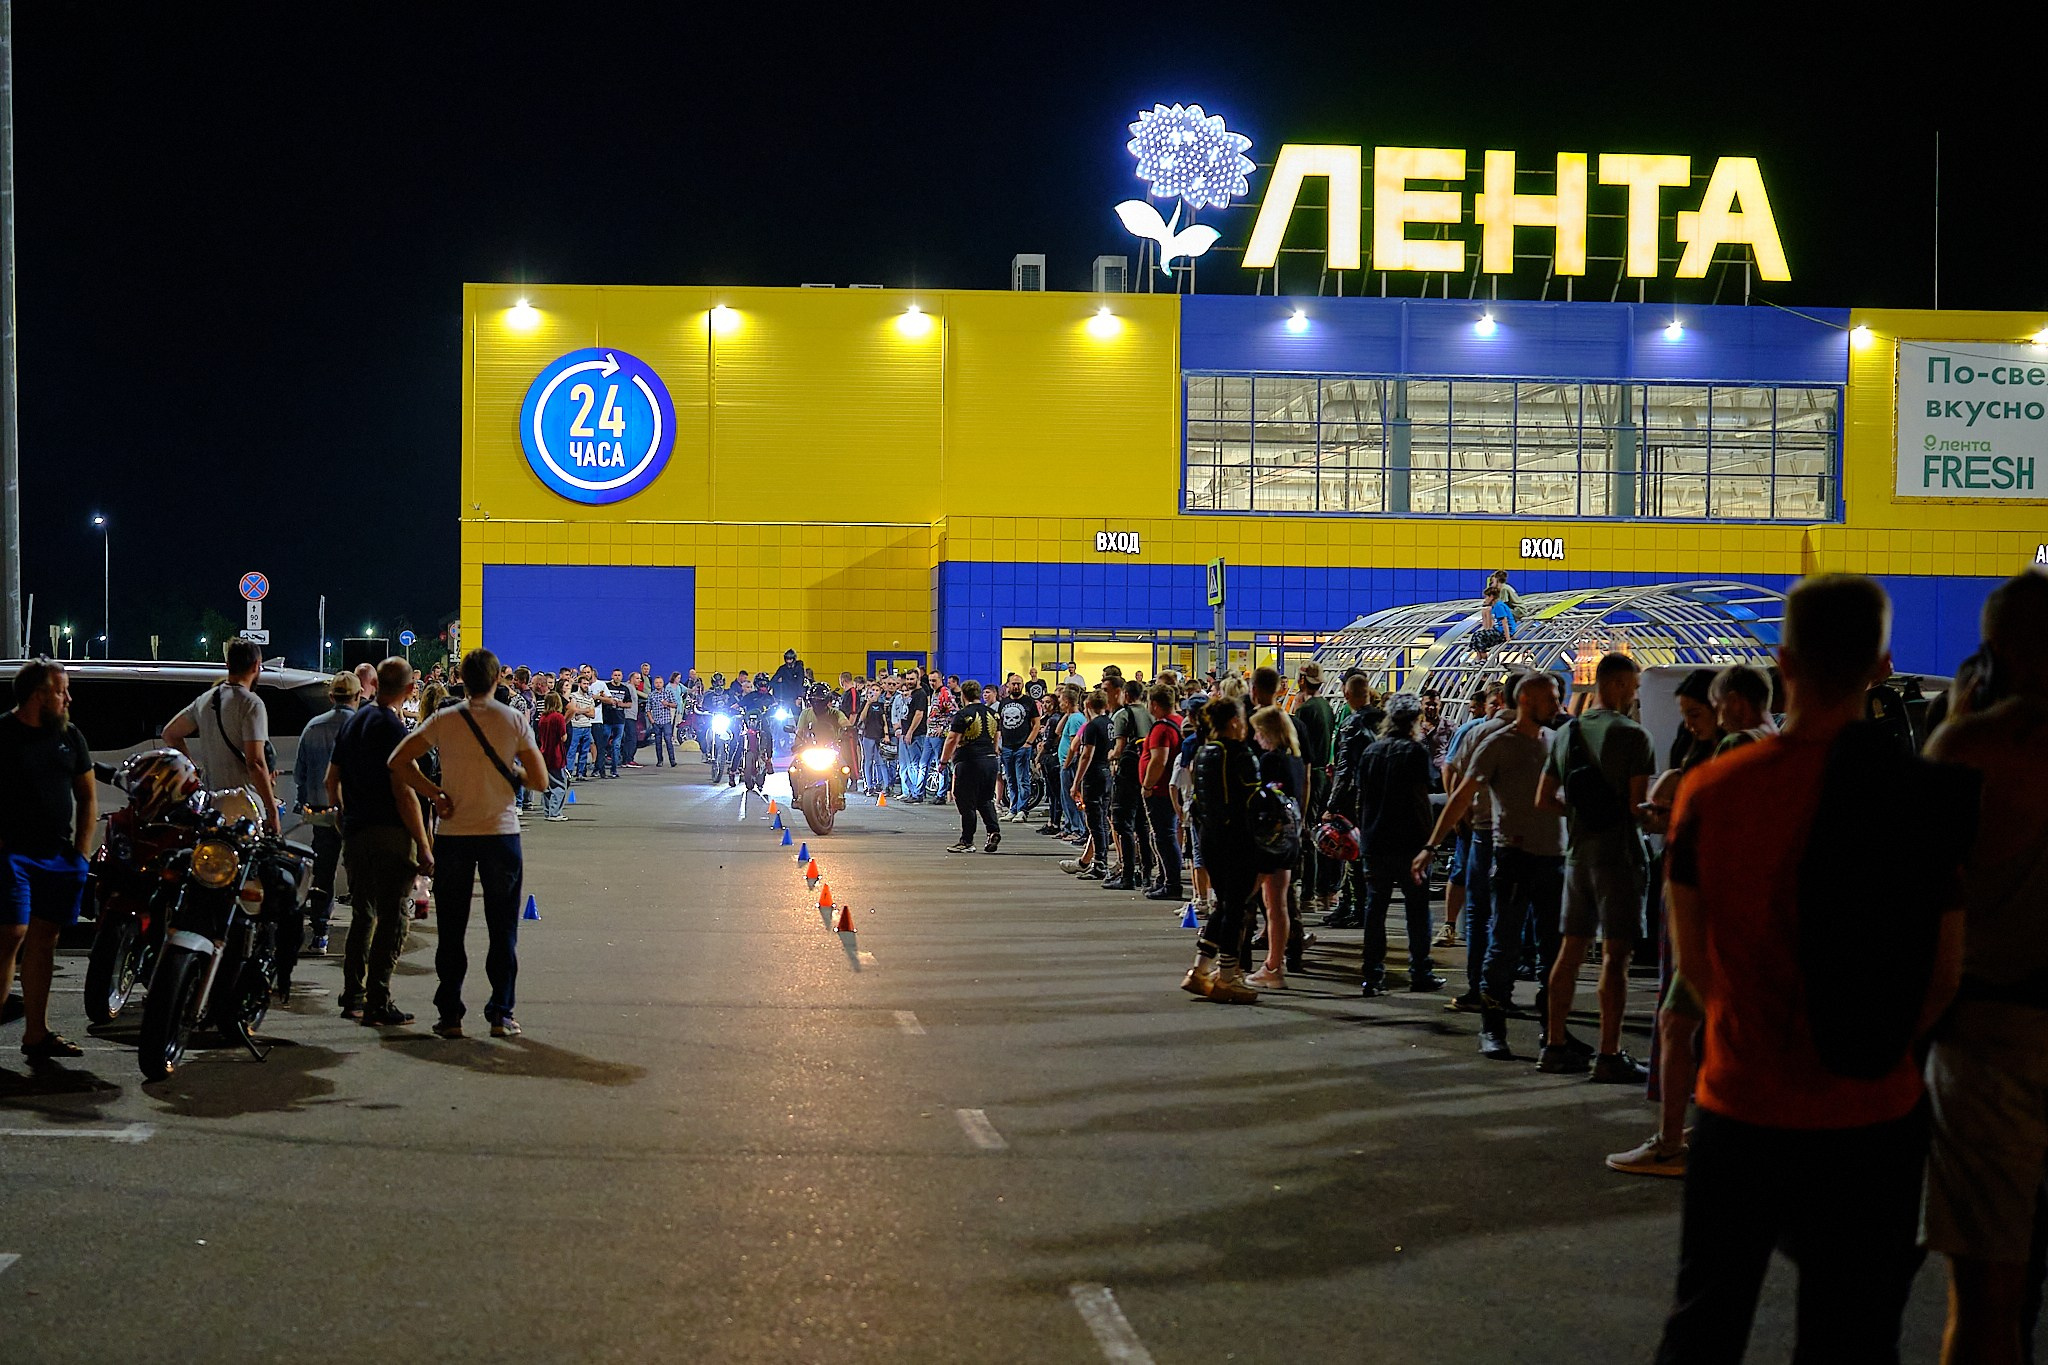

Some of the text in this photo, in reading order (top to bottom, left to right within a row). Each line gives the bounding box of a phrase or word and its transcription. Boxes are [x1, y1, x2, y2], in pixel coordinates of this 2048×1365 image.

[1241, 143, 1792, 281] ЛЕНТА
[1928, 357, 2048, 385] По-све
[569, 383, 626, 438] 24
[1926, 399, 2045, 427] вкусно
[569, 441, 626, 468] ЧАСА
[1939, 440, 1992, 452] лента
[1923, 455, 2035, 490] FRESH
[1096, 531, 1140, 554] ВХОД
[1521, 538, 1564, 560] ВХОД
